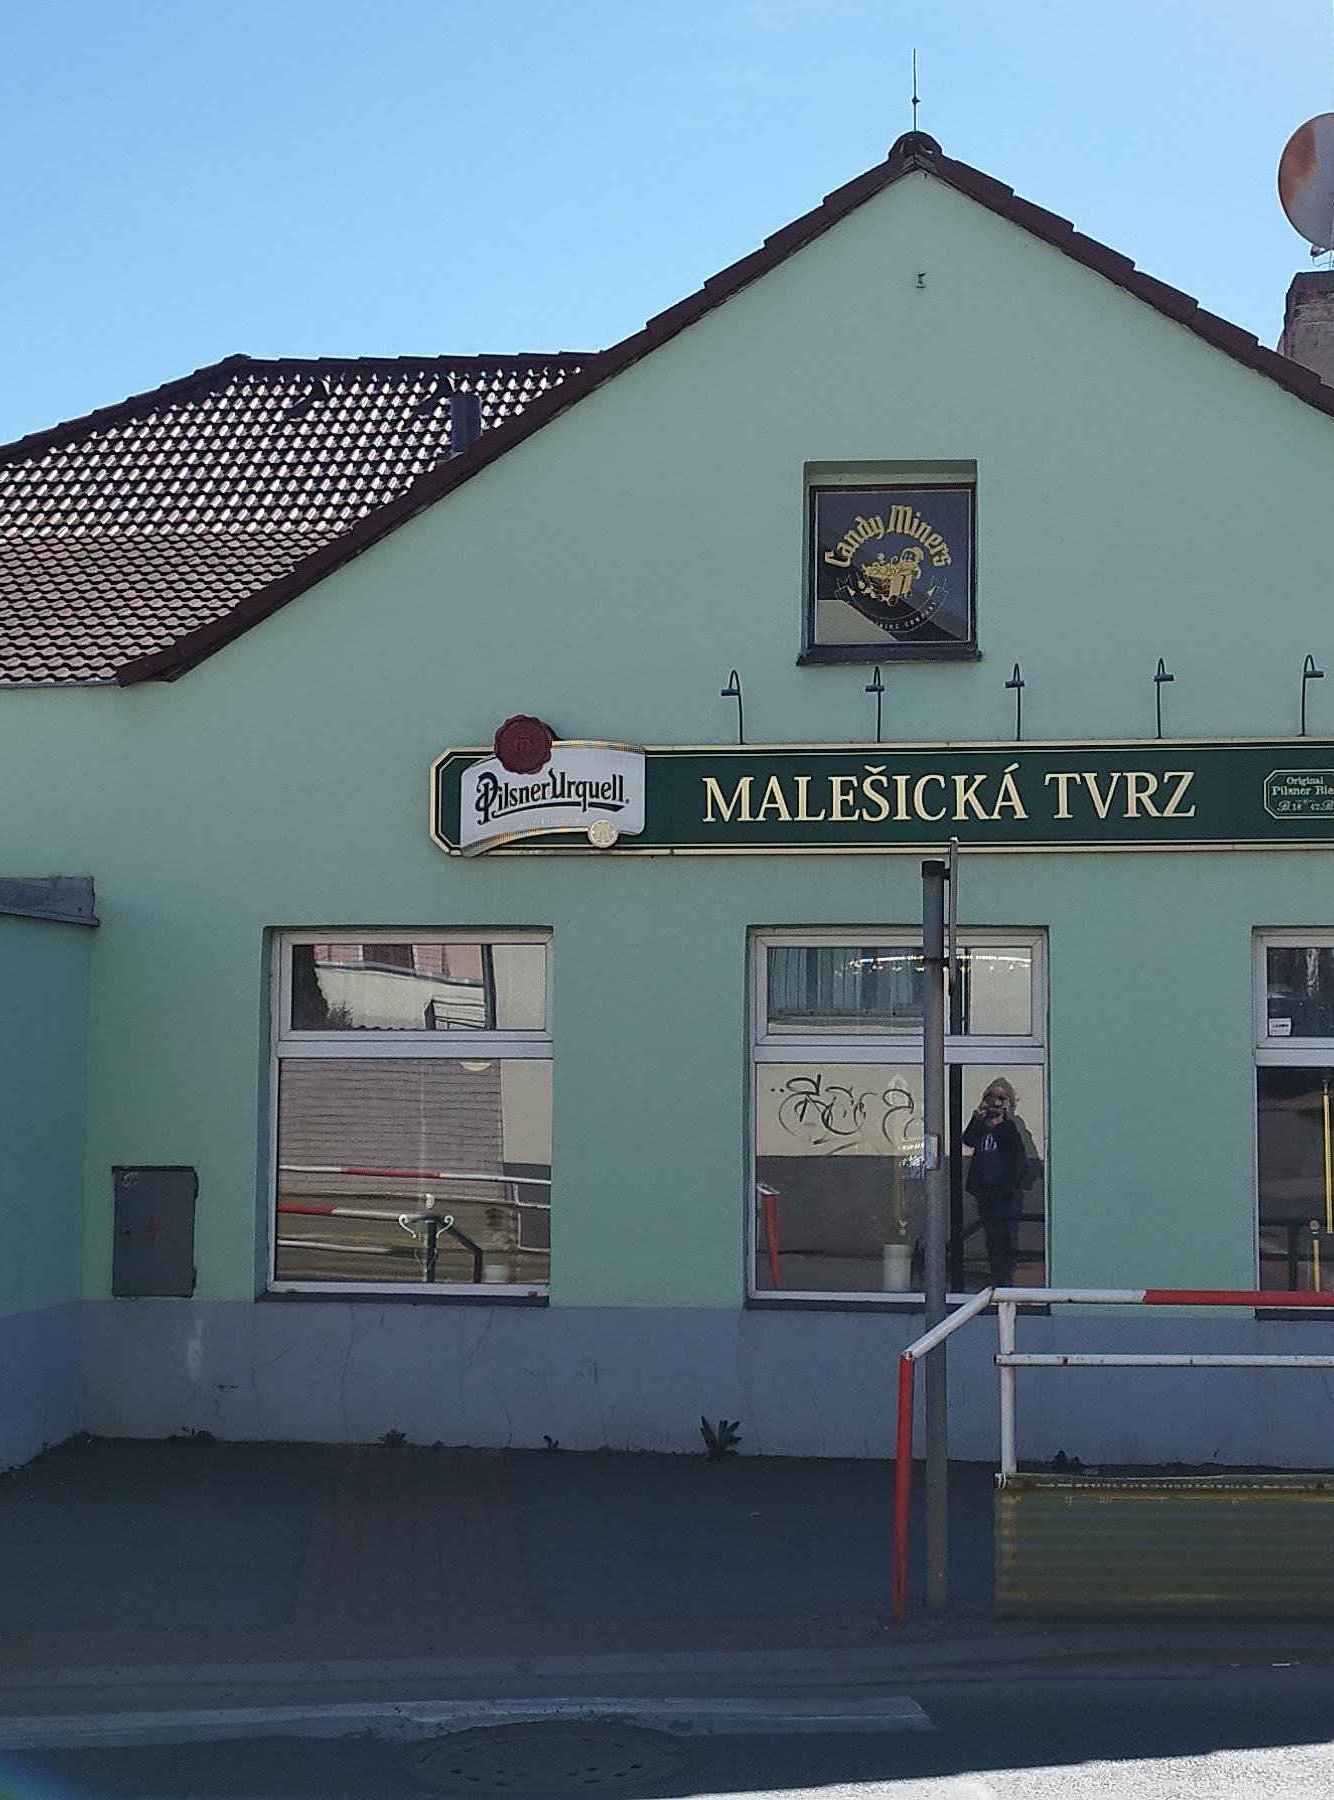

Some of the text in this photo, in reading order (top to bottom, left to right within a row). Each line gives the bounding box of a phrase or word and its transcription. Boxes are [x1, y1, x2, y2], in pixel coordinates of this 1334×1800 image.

[824, 504, 952, 568] Candy Miners
[475, 768, 624, 826] Pilsner Urquell
[701, 762, 1196, 822] MALEŠICKÁ TVRZ
[1271, 786, 1312, 795] Pilsner
[1286, 776, 1324, 786] Original
